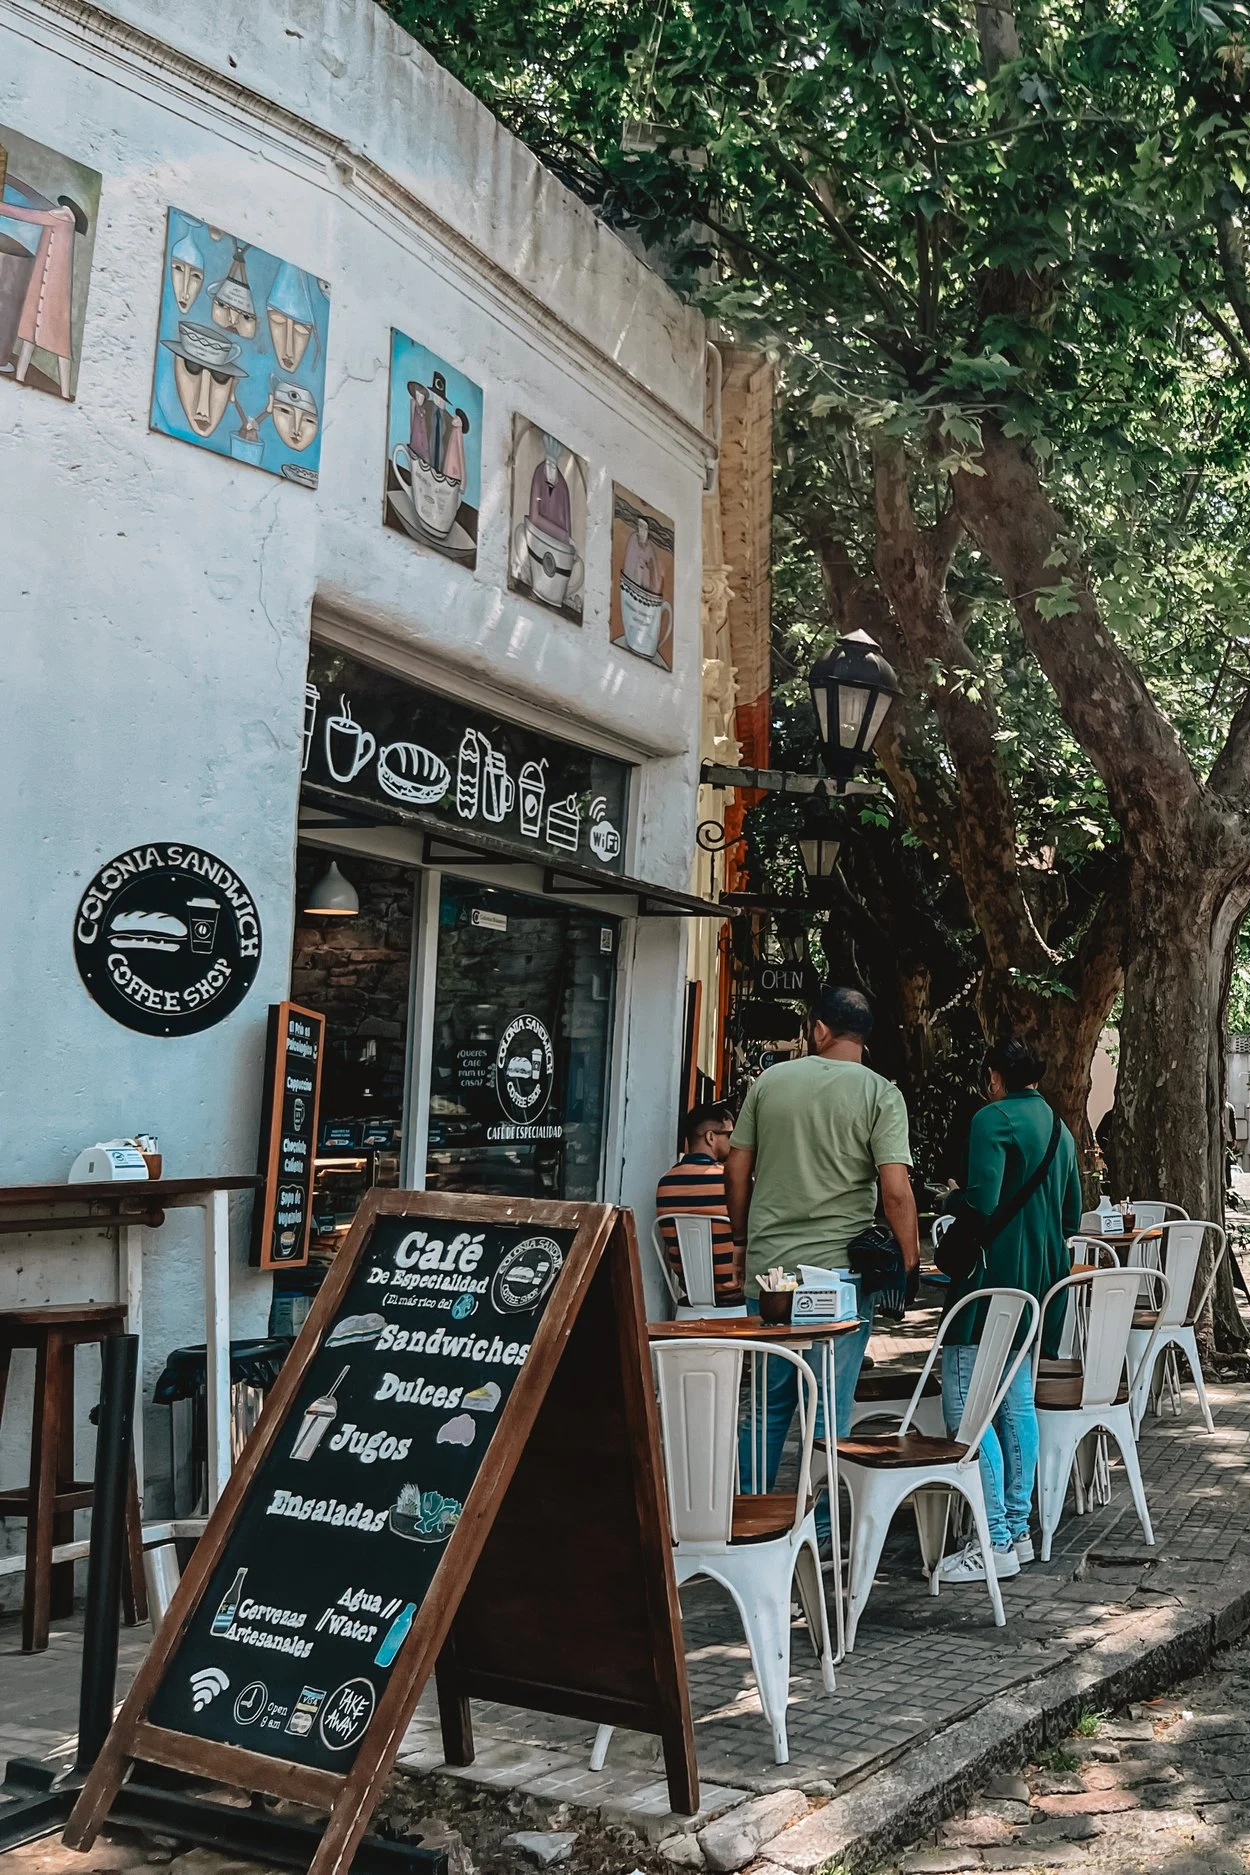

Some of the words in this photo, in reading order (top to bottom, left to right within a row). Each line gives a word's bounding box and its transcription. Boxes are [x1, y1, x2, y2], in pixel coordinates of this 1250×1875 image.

[77, 847, 165, 944] COLONIA
[167, 846, 259, 958] SANDWICH
[107, 954, 180, 1011] COFFEE
[183, 958, 232, 1007] SHOP
[761, 969, 803, 990] OPEN
[498, 1019, 525, 1068] COLONIA
[526, 1018, 553, 1075] SANDWICH
[507, 1081, 527, 1107] COFFEE
[528, 1083, 541, 1107] SHOP
[506, 1126, 515, 1139] DE
[516, 1125, 563, 1139] ESPECIALIDAD
[395, 1230, 486, 1273] Café
[539, 1239, 562, 1275] SANDWIC
[366, 1267, 389, 1284] De
[390, 1269, 490, 1294] Especialidad
[417, 1297, 437, 1308] rico
[437, 1298, 453, 1310] del
[374, 1323, 532, 1366] Sandwiches
[374, 1372, 464, 1409] Dulces
[329, 1423, 413, 1464] Jugos
[266, 1489, 390, 1532] Ensaladas
[238, 1598, 307, 1628] Cervezas
[225, 1622, 314, 1659] Artesanales
[338, 1688, 370, 1719] TAKE
[268, 1719, 281, 1729] am
[324, 1709, 358, 1740] AWAY
